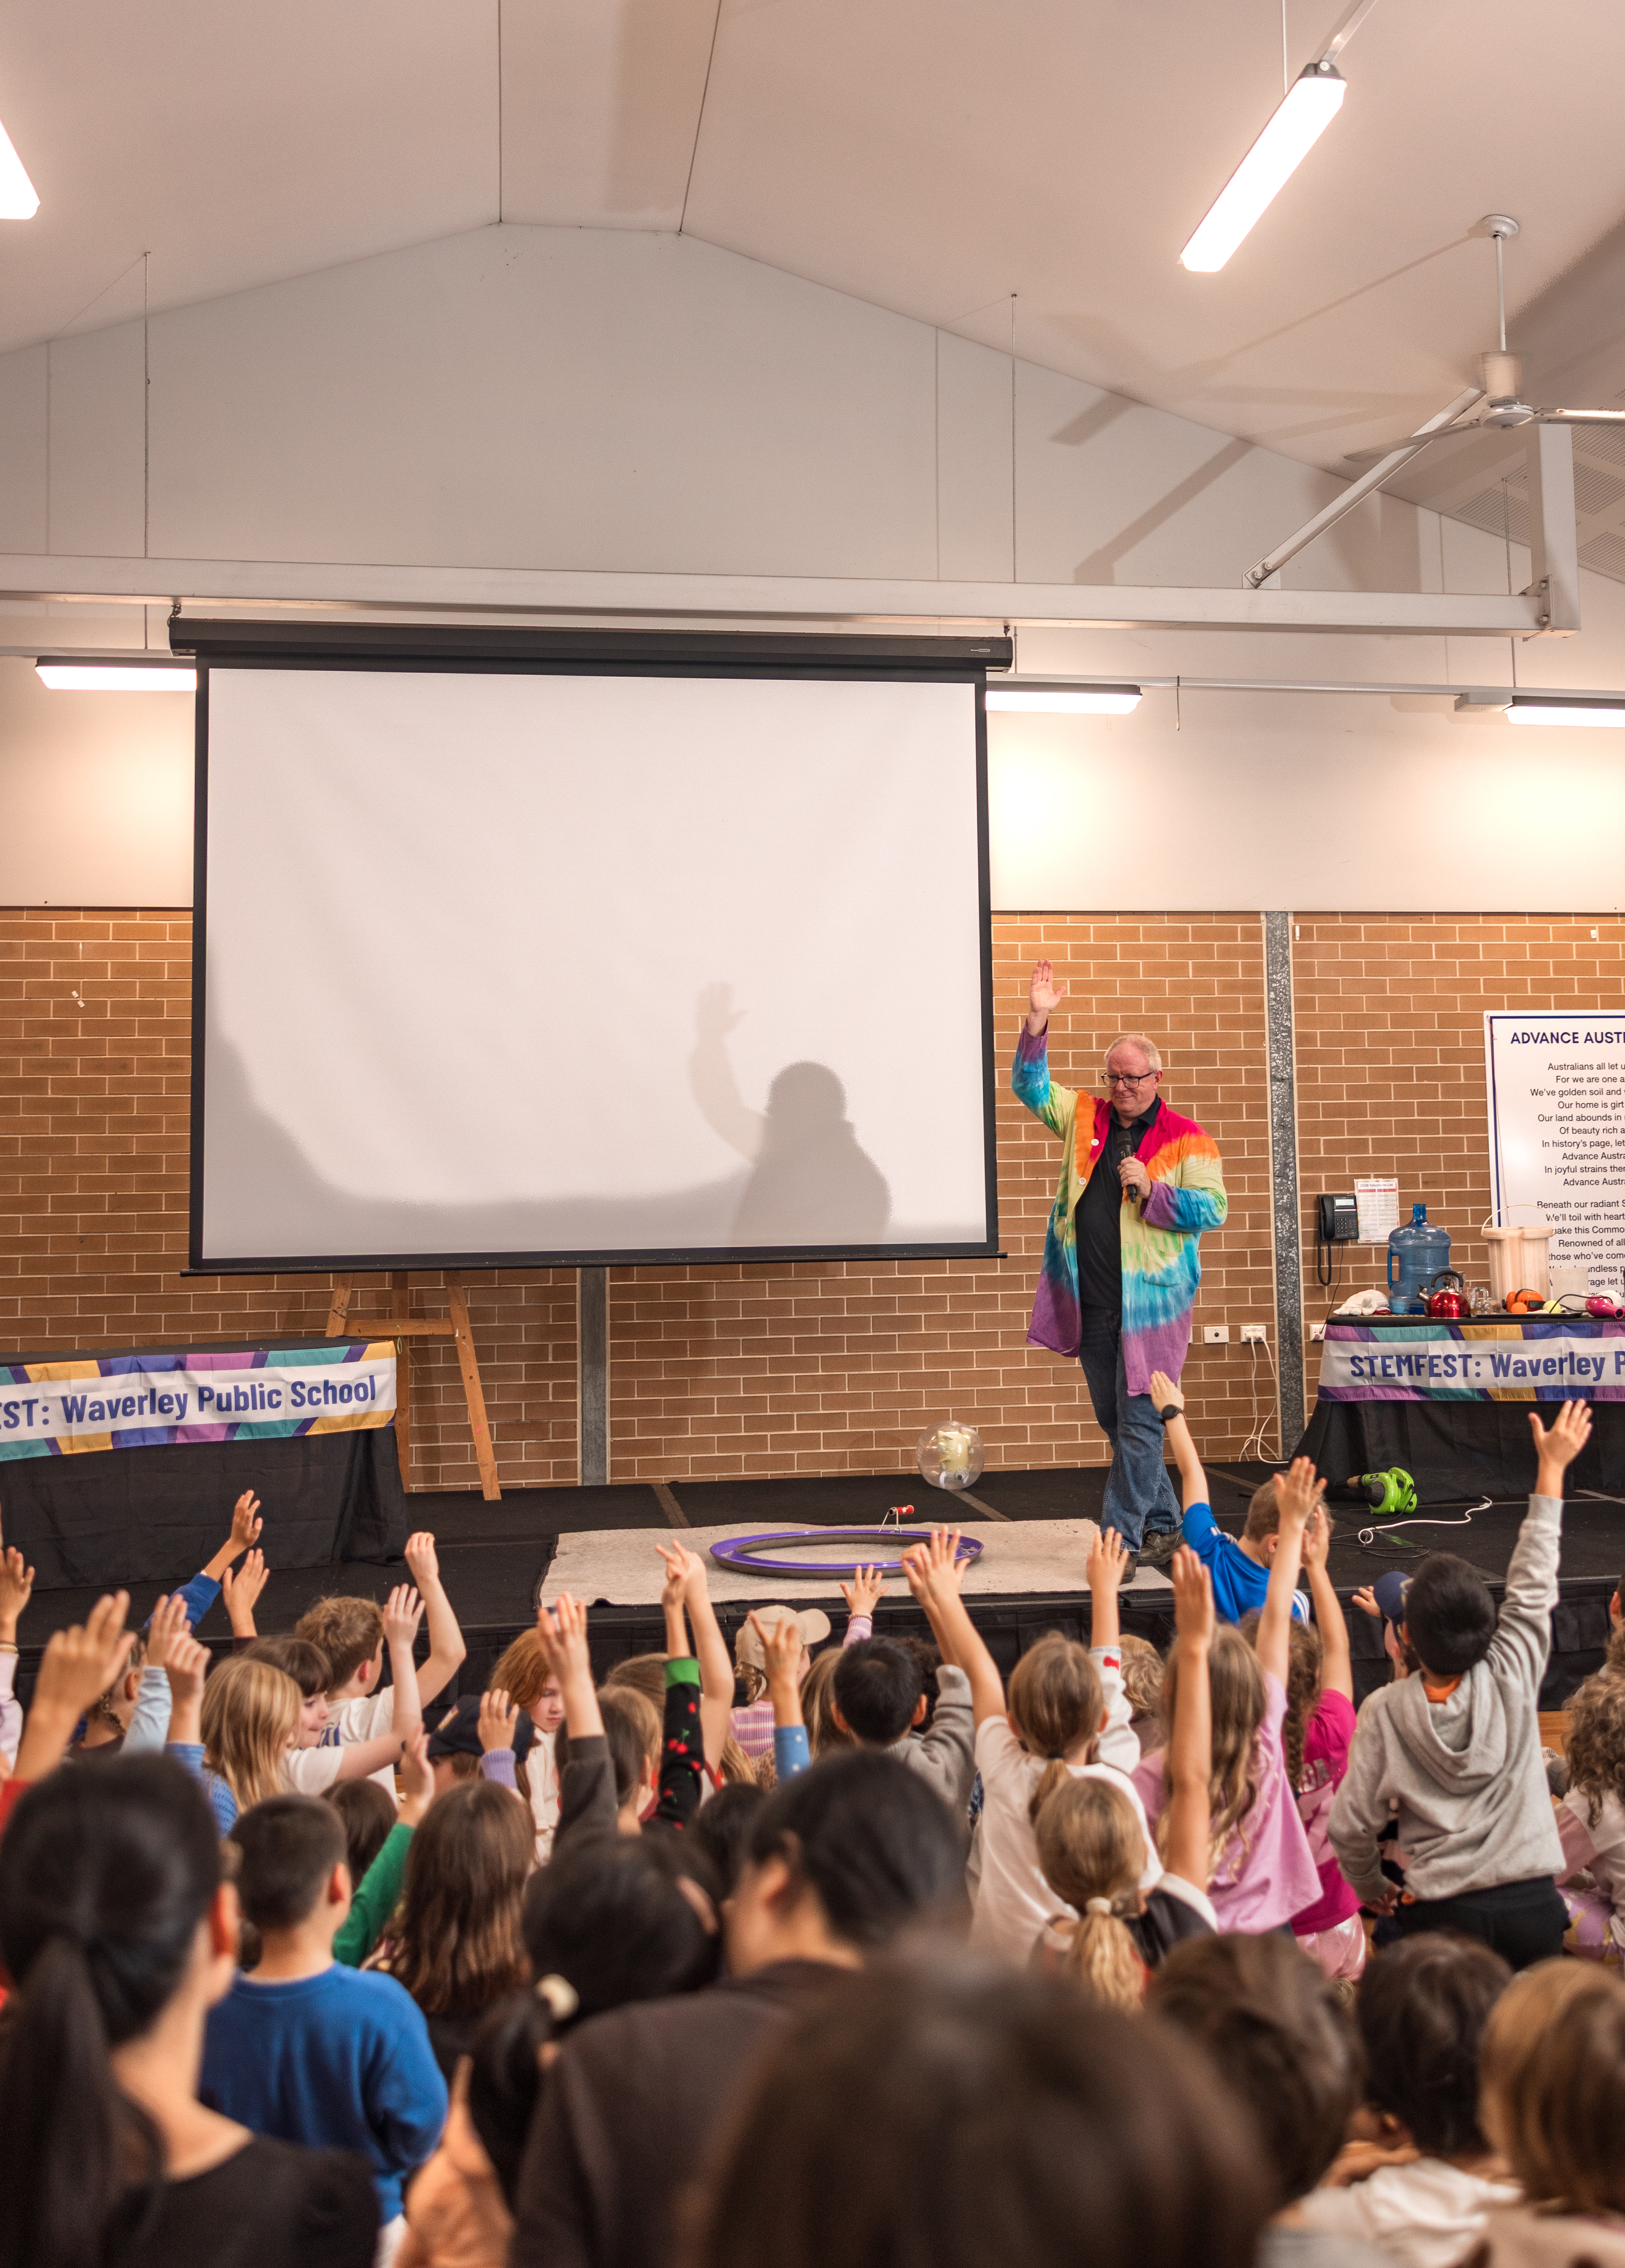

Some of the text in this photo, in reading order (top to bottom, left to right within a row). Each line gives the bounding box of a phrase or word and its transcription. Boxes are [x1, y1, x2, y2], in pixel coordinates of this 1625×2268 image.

[1511, 1031, 1625, 1044] ADVANCE AUST
[1558, 1088, 1586, 1098] golden
[1610, 1100, 1624, 1110] girt
[1572, 1127, 1600, 1135] beauty
[1552, 1139, 1587, 1149] history’s
[1555, 1165, 1577, 1175] joyful
[1559, 1239, 1603, 1247] Renowned
[1350, 1354, 1481, 1378] STEMFEST:
[1489, 1351, 1605, 1381] Waverley
[0, 1375, 376, 1429] ST: Waverley Public School
